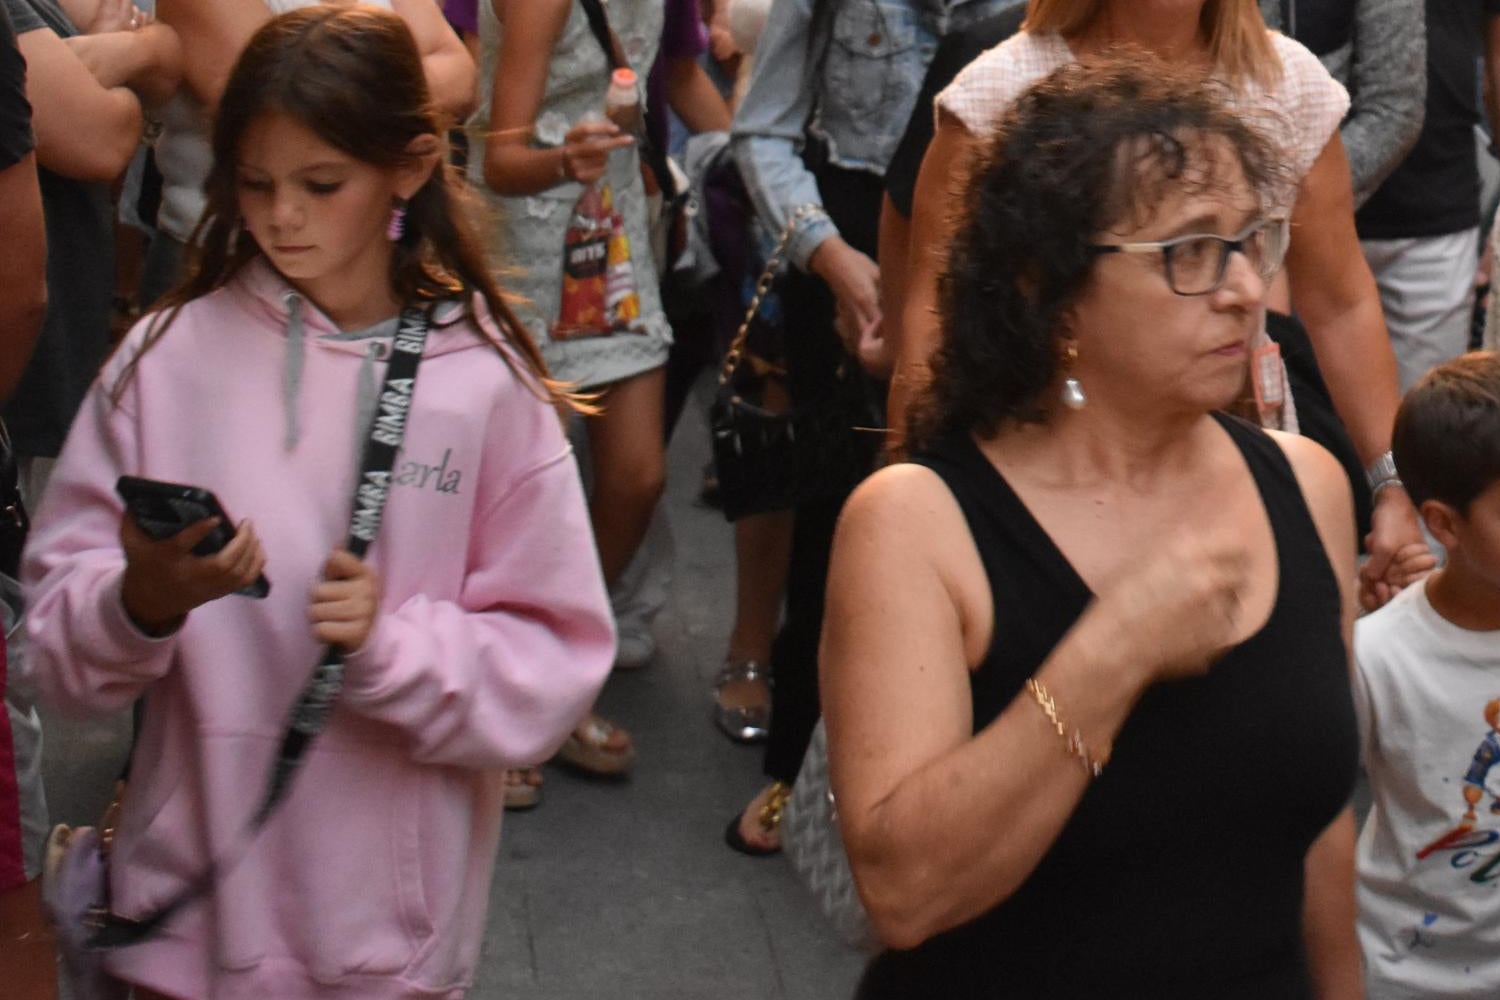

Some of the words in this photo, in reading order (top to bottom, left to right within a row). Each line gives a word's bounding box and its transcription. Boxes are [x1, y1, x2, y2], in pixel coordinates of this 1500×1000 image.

[371, 378, 415, 446] BIMBA
[393, 447, 462, 494] arla
[350, 470, 392, 541] BIMBA
